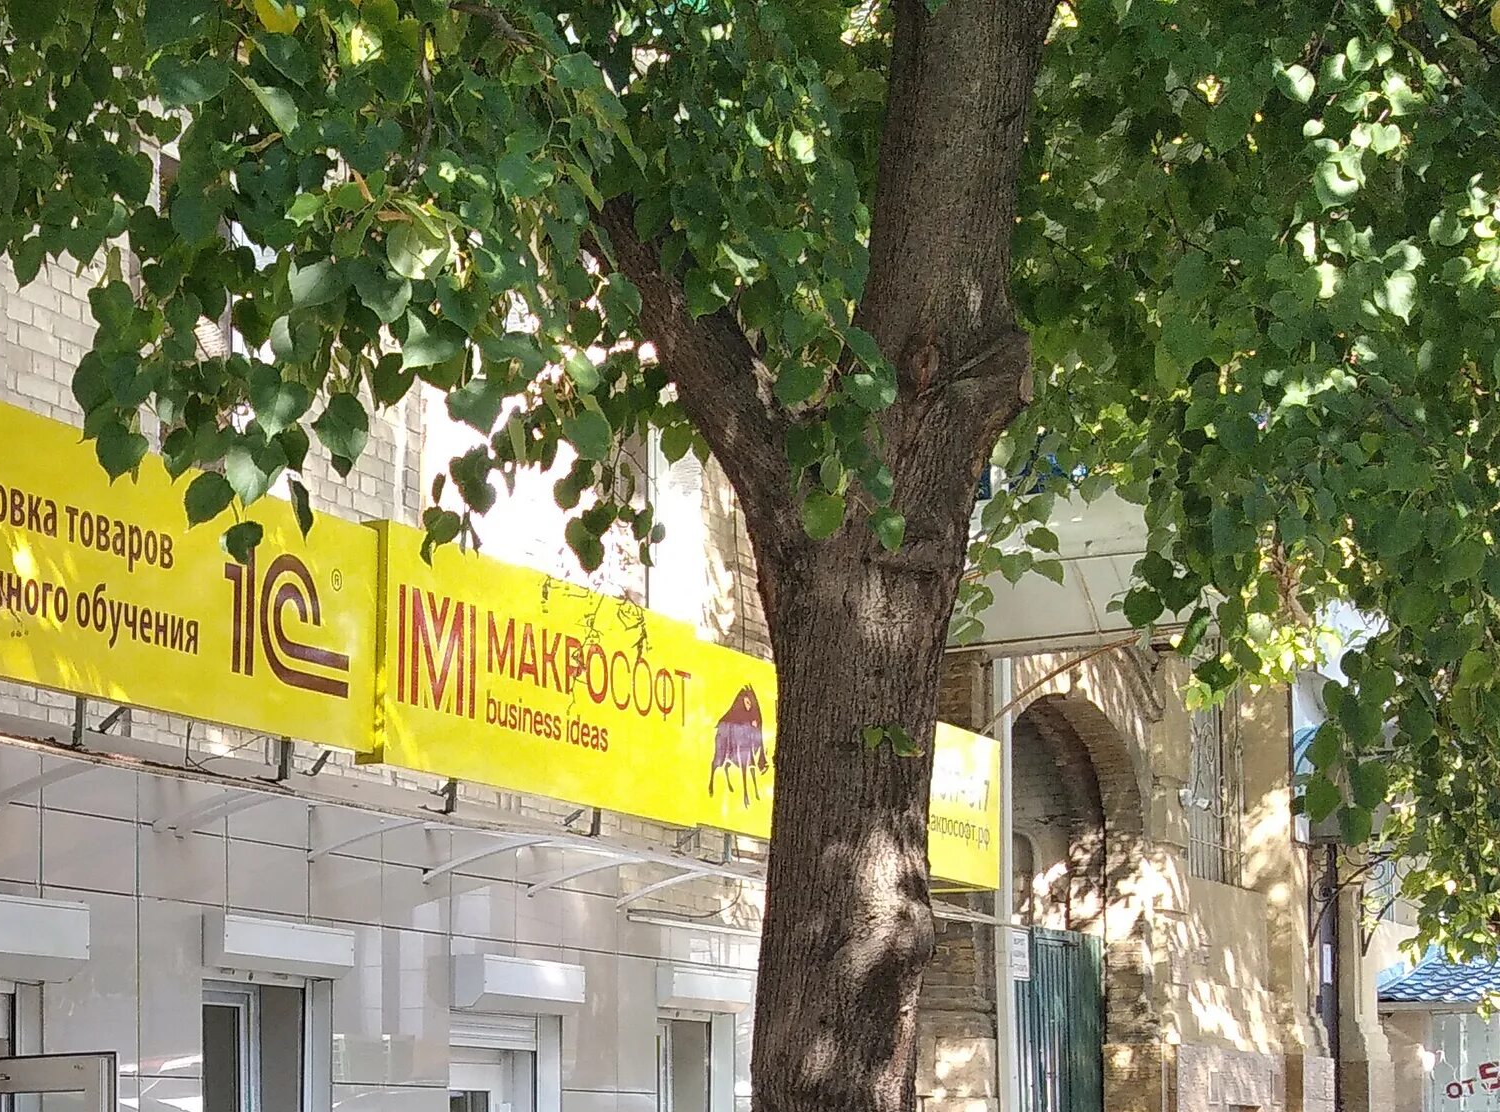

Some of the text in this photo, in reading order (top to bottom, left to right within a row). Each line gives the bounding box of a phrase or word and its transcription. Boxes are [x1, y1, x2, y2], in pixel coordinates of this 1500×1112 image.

[65, 504, 175, 572] товаров
[76, 582, 199, 655] обучения
[487, 610, 692, 727] МАКРОСОФТ
[486, 690, 609, 753] business ideas
[930, 814, 991, 851] акрософт.рф
